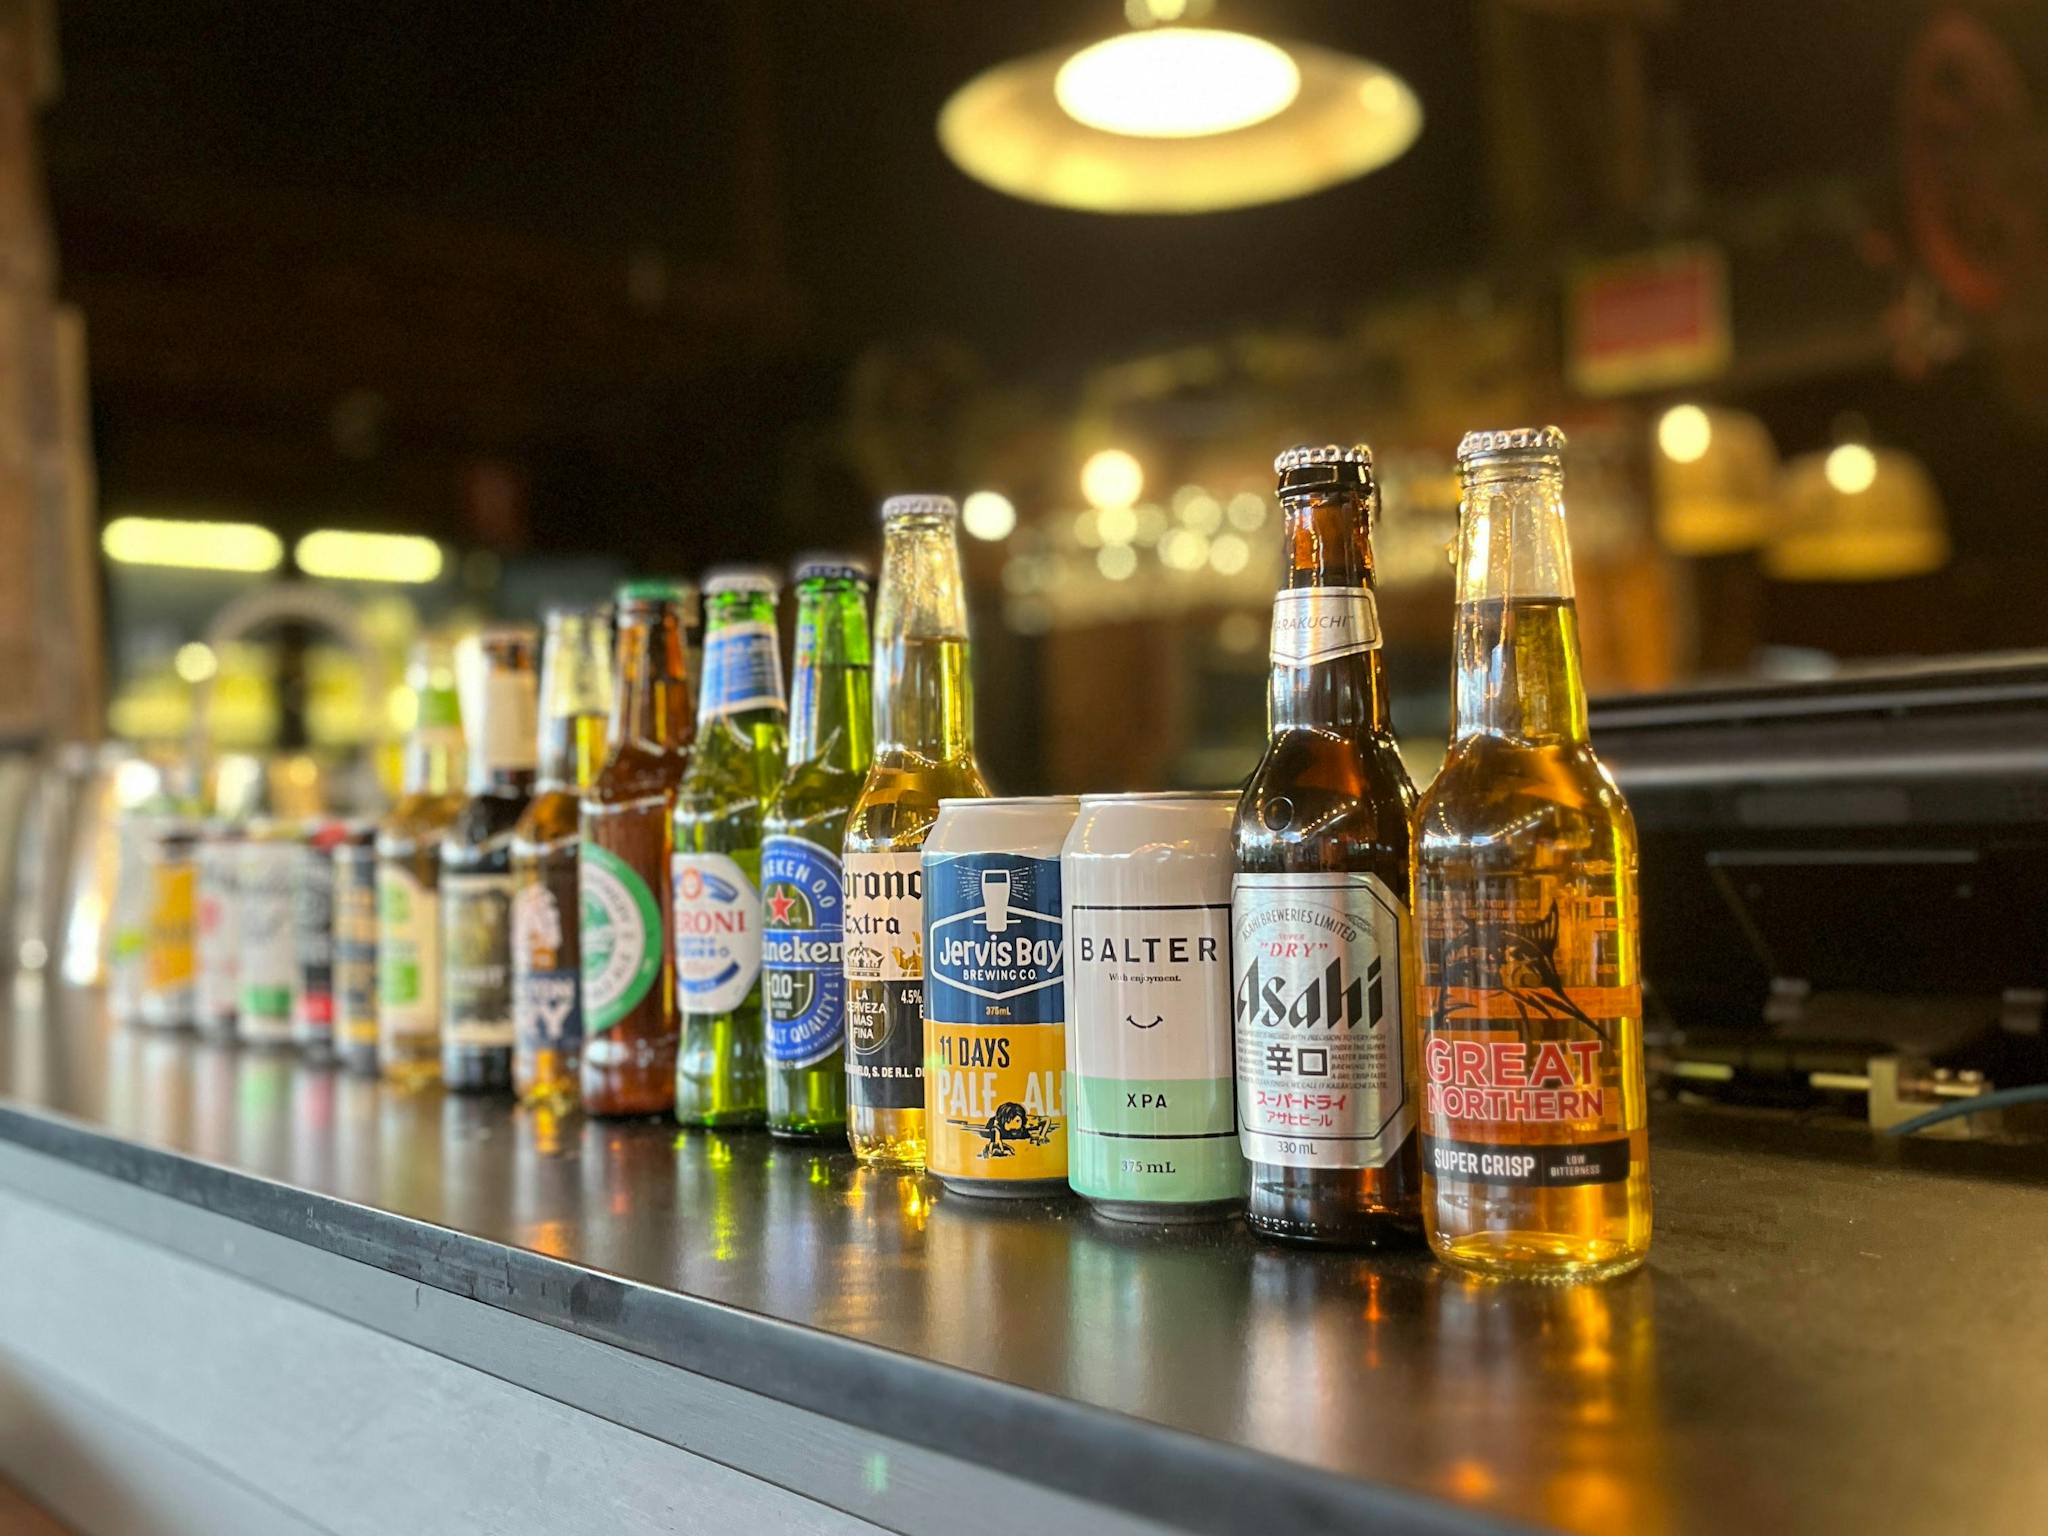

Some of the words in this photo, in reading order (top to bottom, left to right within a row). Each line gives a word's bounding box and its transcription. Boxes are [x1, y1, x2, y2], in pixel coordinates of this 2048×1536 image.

[845, 903, 900, 935] Extra
[1260, 907, 1313, 926] BREWERIES
[1314, 912, 1357, 943] LIMITED
[939, 934, 1013, 967] Jervis
[1015, 937, 1064, 974] Bay
[1081, 937, 1218, 963] BALTER
[963, 969, 1017, 981] BREWING
[1130, 973, 1182, 984] enjoyment.
[856, 989, 869, 1001] LA
[1237, 954, 1383, 1030] Asahi
[789, 990, 837, 1044] QUALITY
[853, 1014, 874, 1027] MAS
[853, 1027, 874, 1040] FINA
[939, 1035, 953, 1065] 11
[958, 1036, 1011, 1069] DAYS
[1265, 1042, 1328, 1077] 辛口
[1426, 1038, 1602, 1088] GREAT
[881, 1066, 894, 1078] DE
[895, 1067, 913, 1078] R.L.
[938, 1069, 998, 1118] PALE
[1126, 1094, 1168, 1108] XPA
[1257, 1090, 1347, 1111] スーパードライ
[1428, 1084, 1604, 1121] NORTHERN
[1266, 1110, 1333, 1127] アサヒビール
[1278, 1140, 1297, 1154] 330
[1299, 1141, 1318, 1155] mL
[1121, 1160, 1143, 1174] 375
[1147, 1161, 1177, 1175] mL
[1434, 1147, 1479, 1174] SUPER
[1481, 1152, 1536, 1178] CRISP
[1566, 1154, 1586, 1165] LOW
